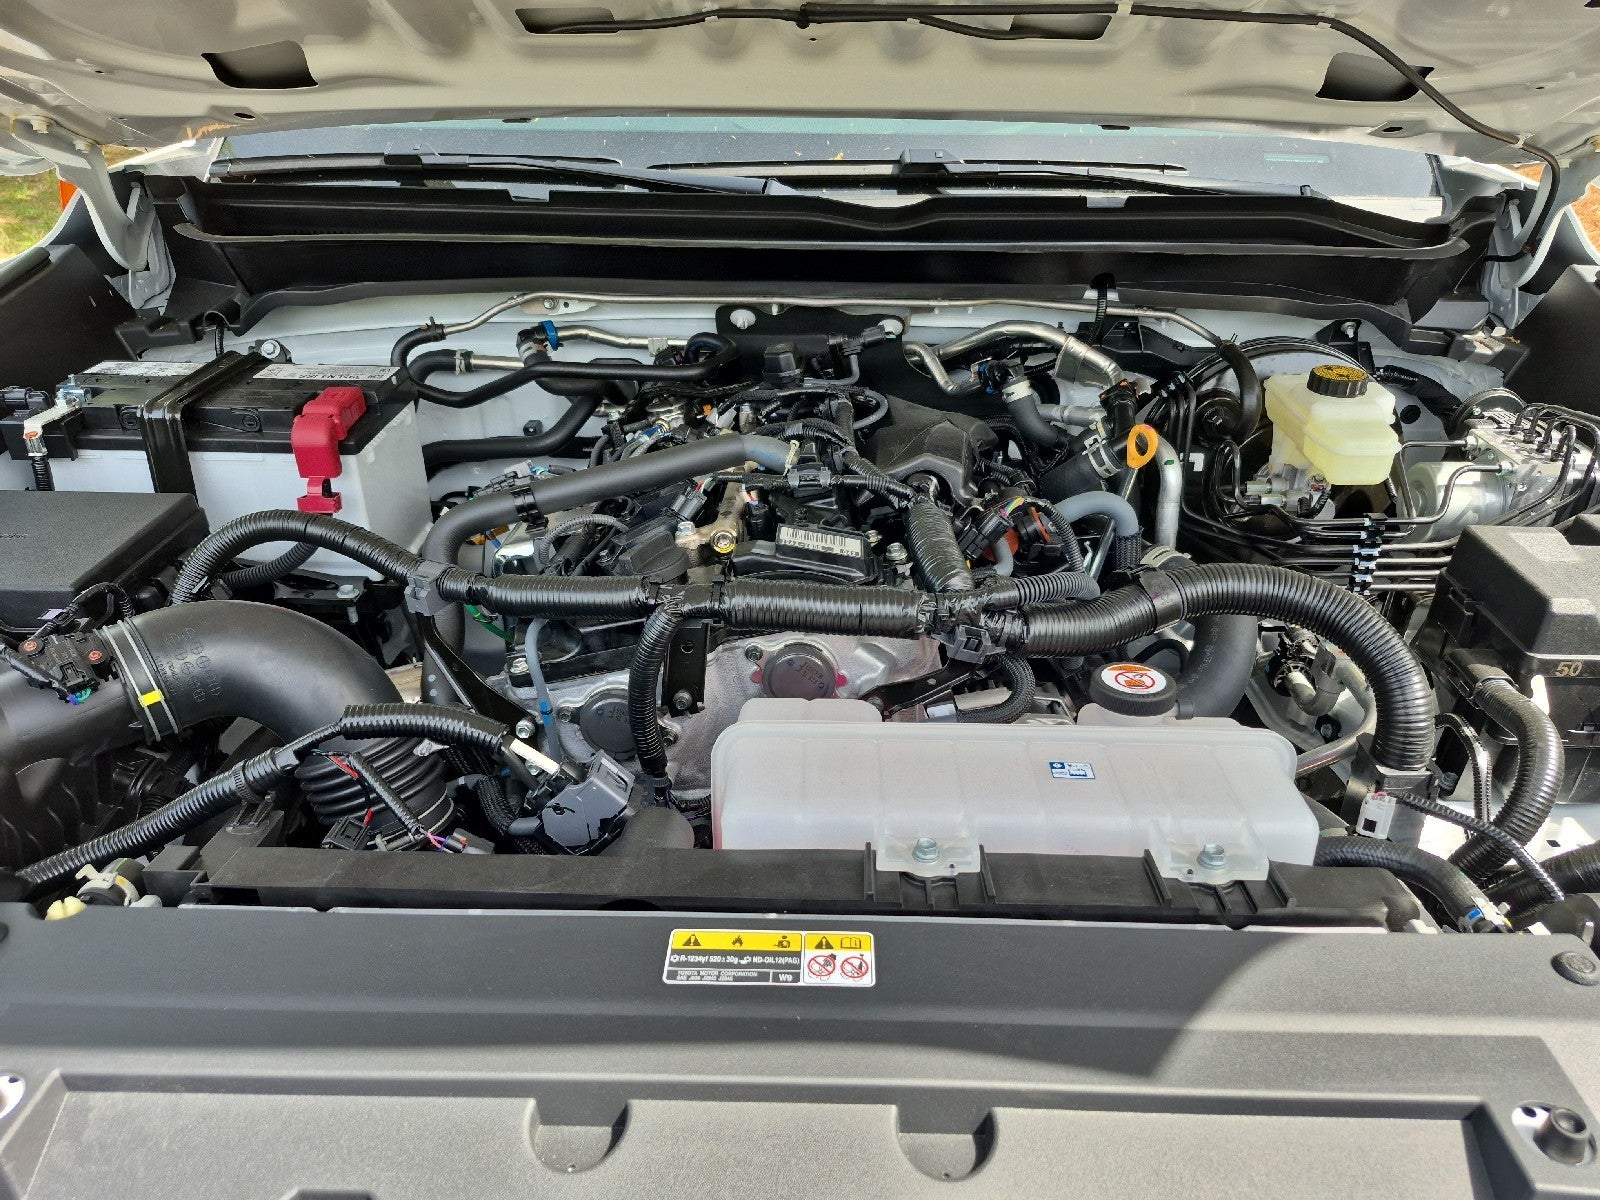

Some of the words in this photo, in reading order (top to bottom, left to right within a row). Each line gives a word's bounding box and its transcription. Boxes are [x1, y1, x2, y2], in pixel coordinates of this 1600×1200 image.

[1555, 661, 1583, 677] 50
[680, 955, 708, 963] R-1234yf
[778, 973, 793, 982] W9
